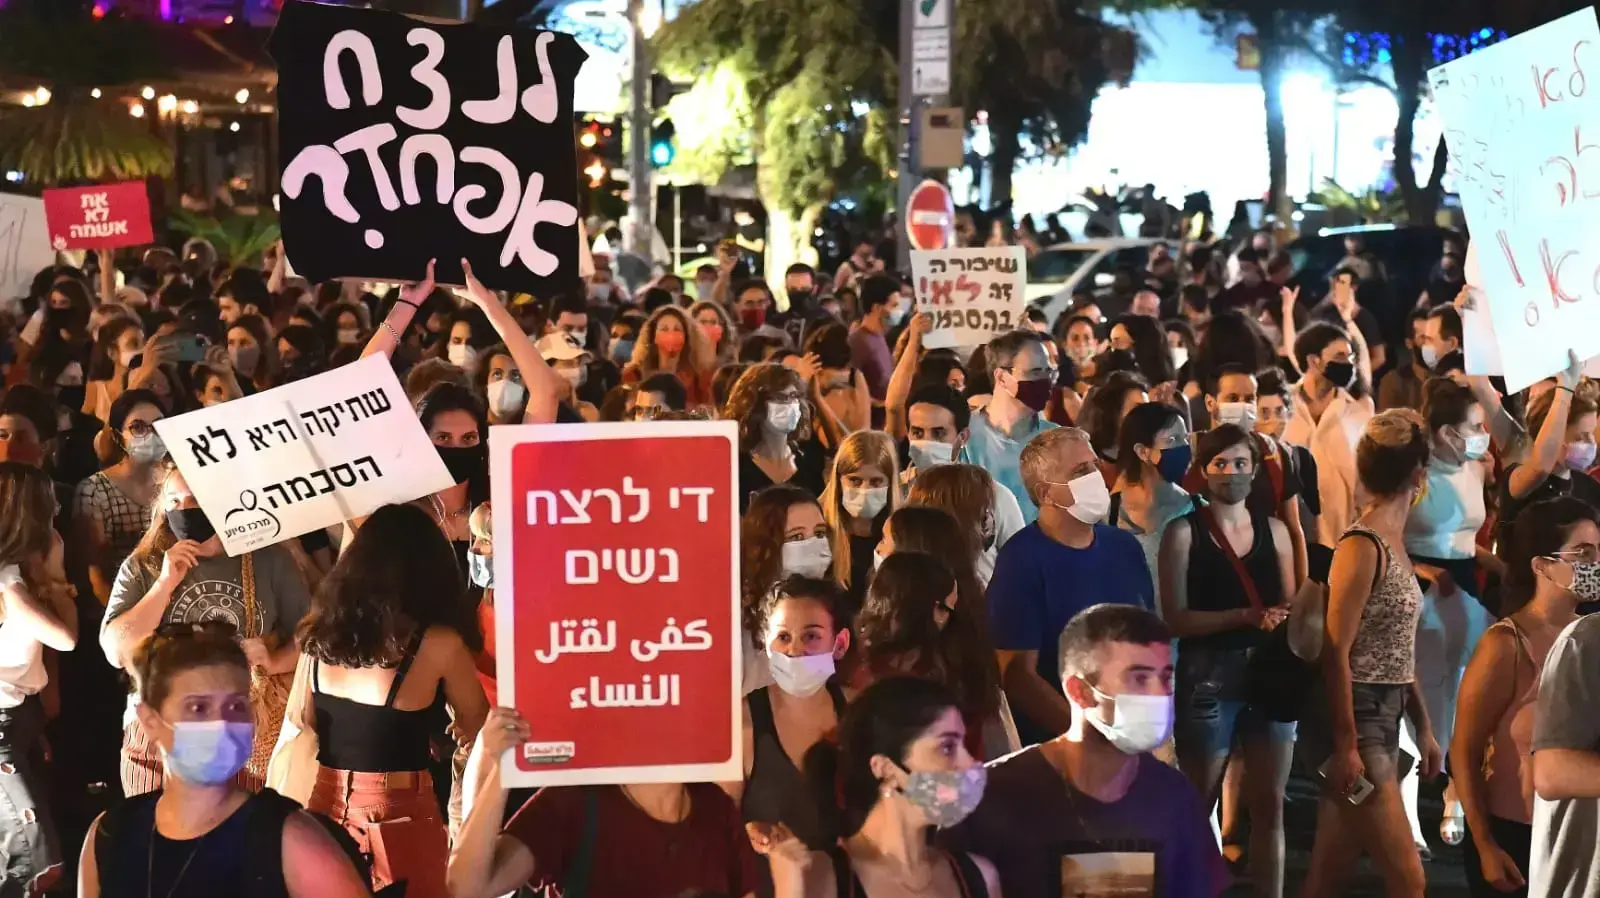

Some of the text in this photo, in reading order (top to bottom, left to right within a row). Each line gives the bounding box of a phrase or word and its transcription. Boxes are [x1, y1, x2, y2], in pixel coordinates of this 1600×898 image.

[323, 27, 558, 130] לנצח
[80, 192, 109, 209] את
[84, 207, 109, 222] לא
[281, 123, 578, 276] אפחד?
[69, 219, 128, 238] אשמה
[929, 257, 1018, 274] שיכורה
[920, 273, 1013, 305] זה לא!
[186, 387, 392, 467] שתיקה היא לא
[262, 455, 383, 509] הסכמה
[525, 476, 715, 526] די לרצח
[224, 525, 246, 538] סיוע
[246, 518, 271, 531] מרכז
[565, 547, 680, 585] נשים
[534, 617, 713, 664] كفى لقتل
[570, 674, 681, 709] النساء
